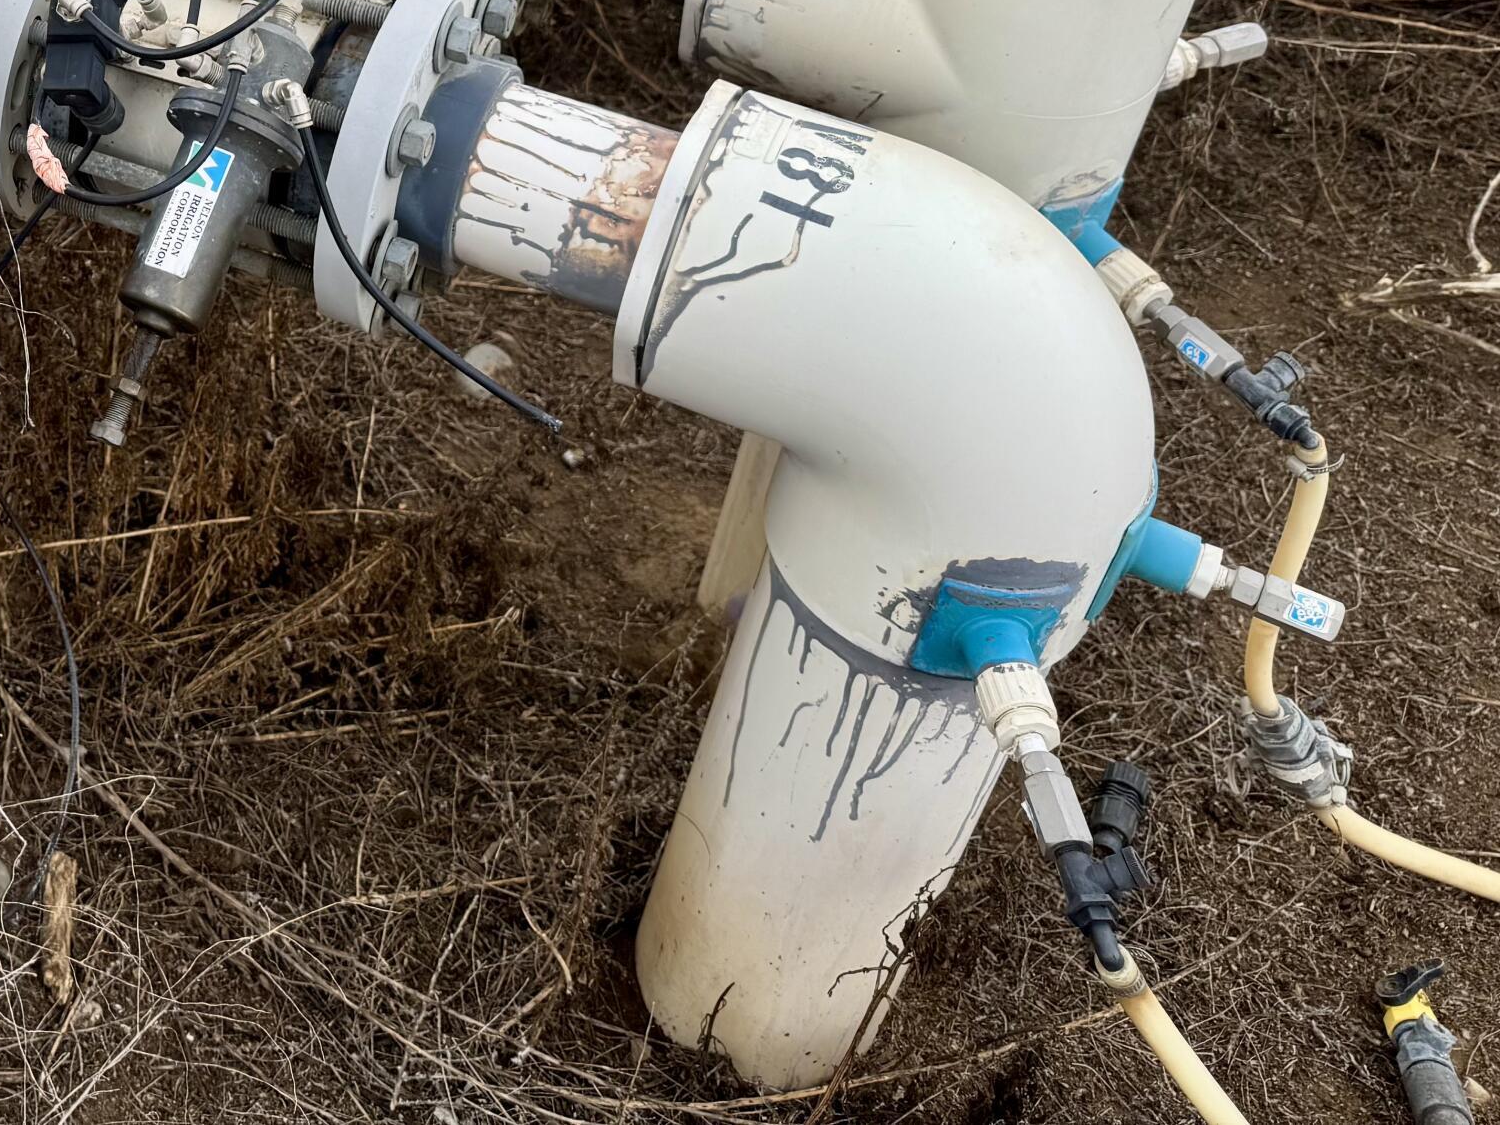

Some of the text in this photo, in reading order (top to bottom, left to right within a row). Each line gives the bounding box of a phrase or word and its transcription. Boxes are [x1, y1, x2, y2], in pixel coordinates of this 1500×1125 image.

[154, 191, 191, 267] CORPORATION
[171, 194, 202, 258] IRRIGATION
[191, 198, 214, 242] NELSON
